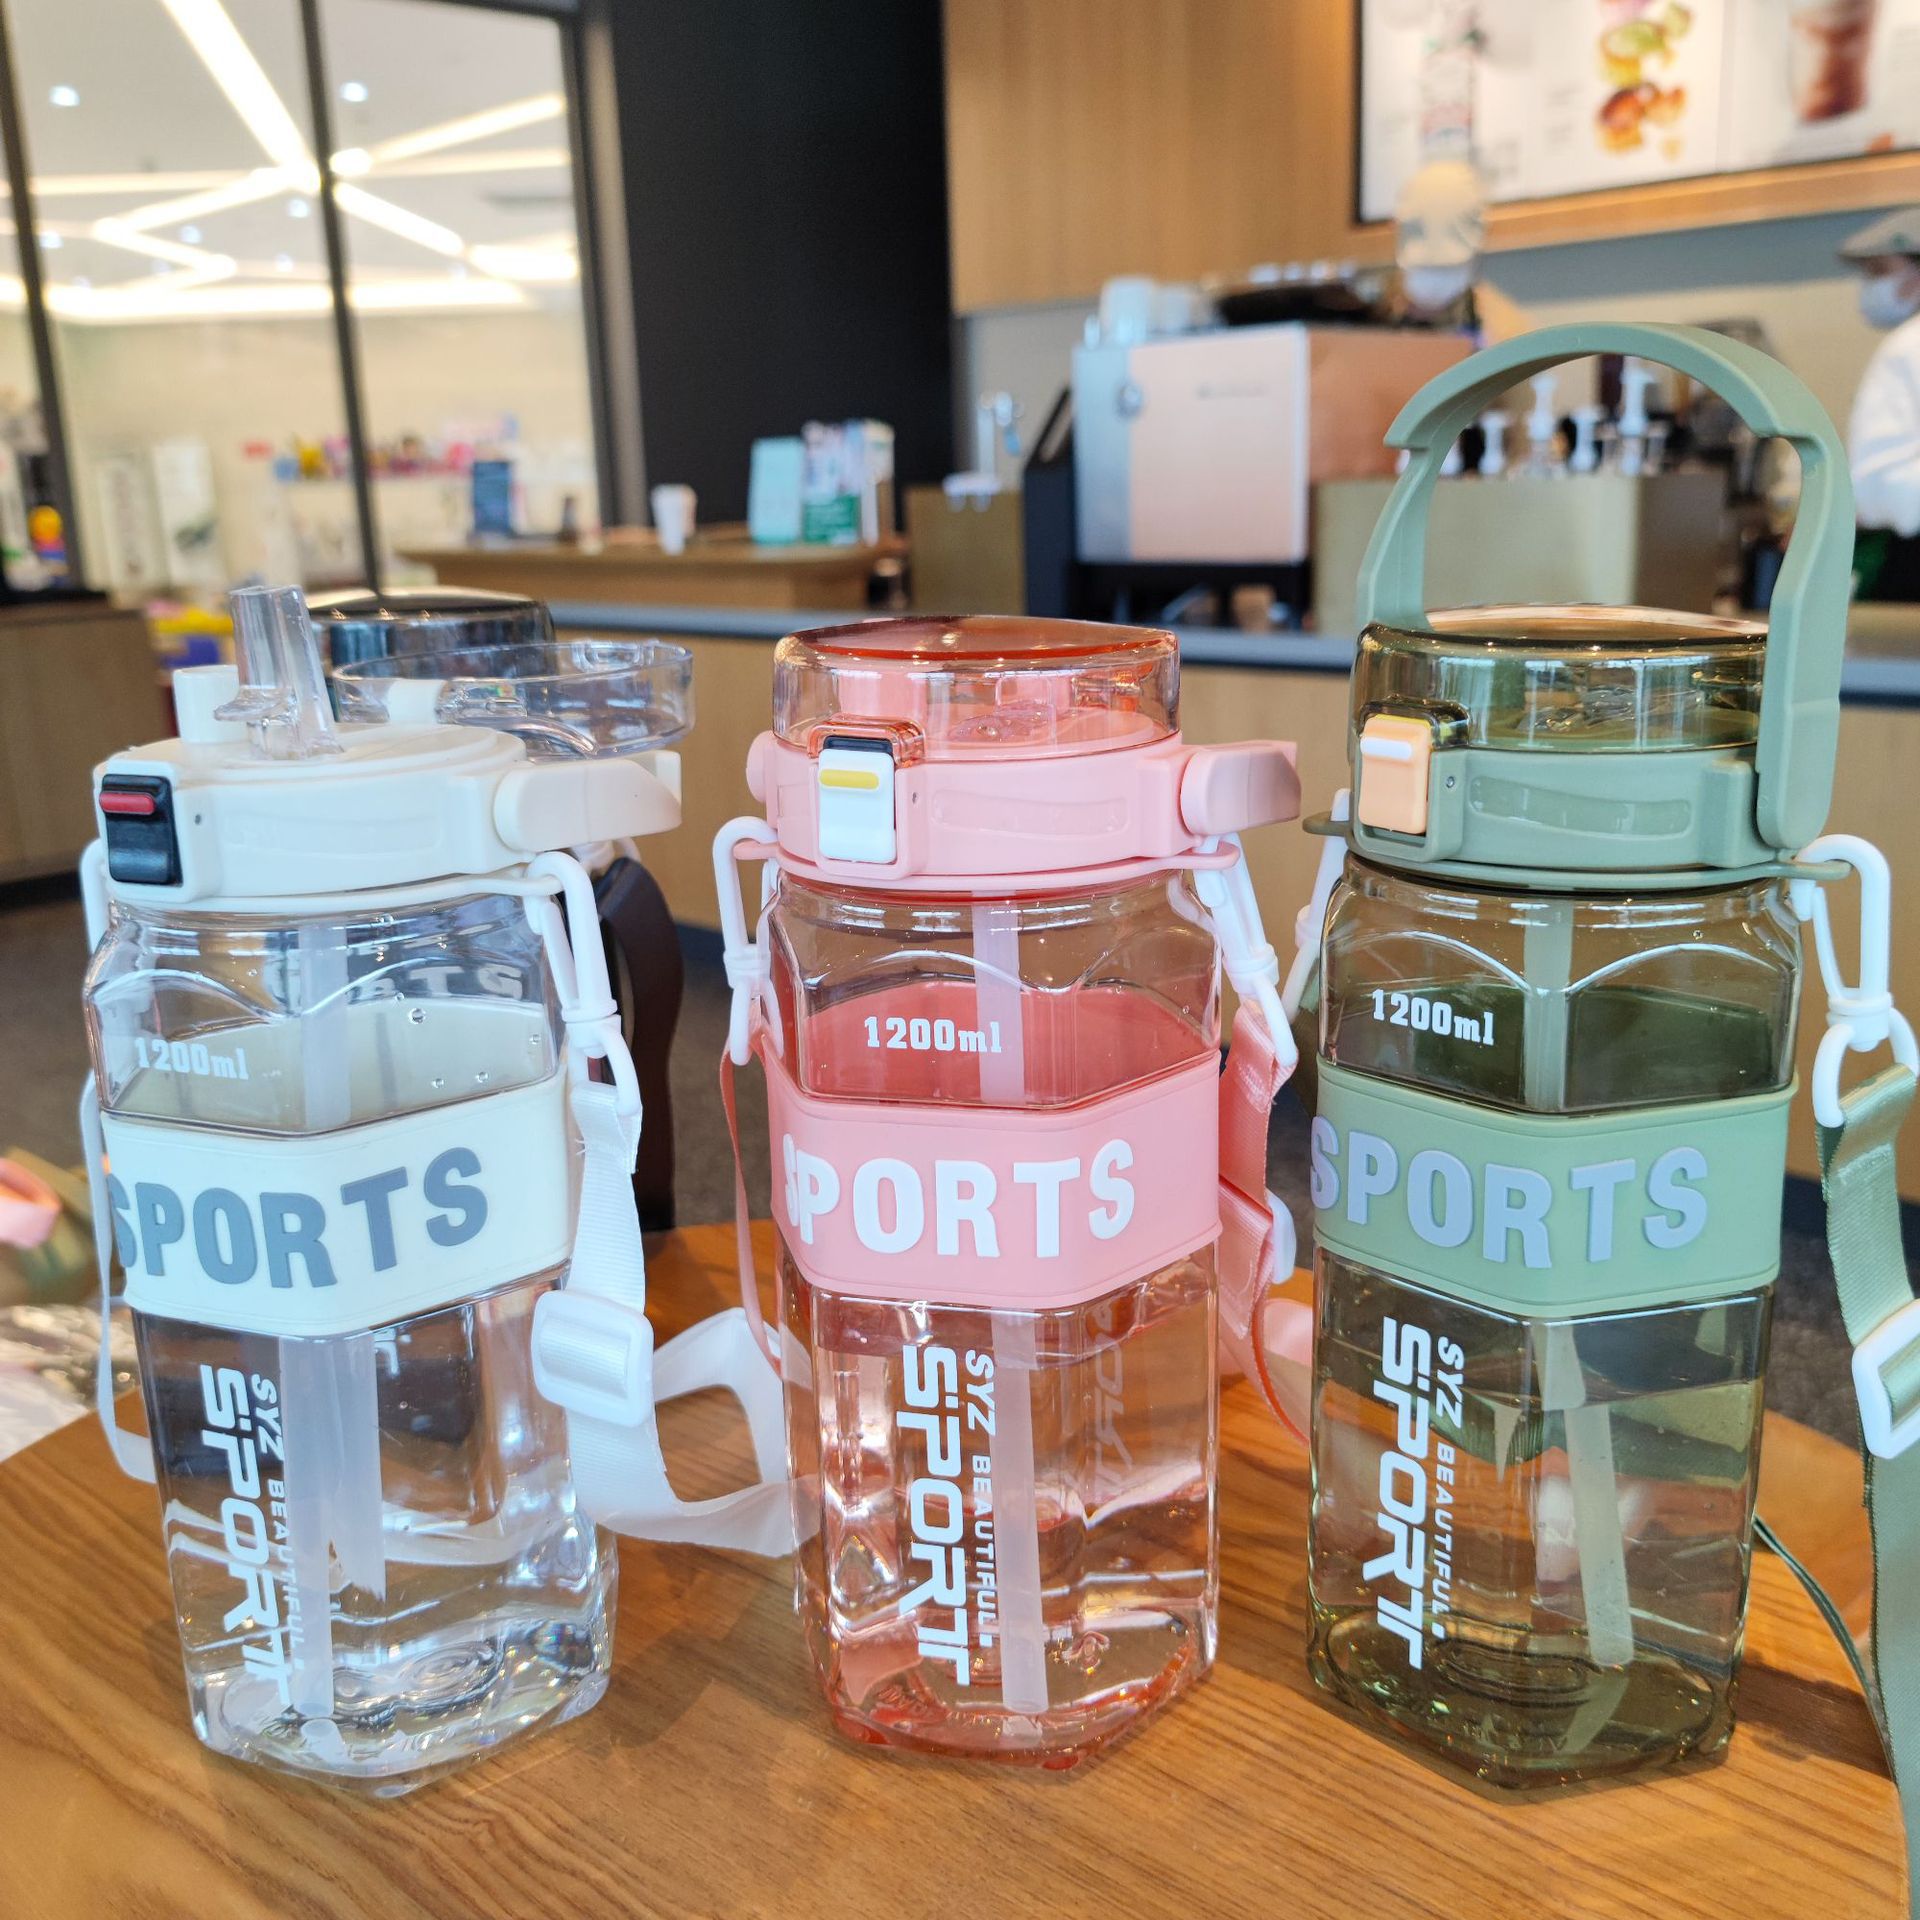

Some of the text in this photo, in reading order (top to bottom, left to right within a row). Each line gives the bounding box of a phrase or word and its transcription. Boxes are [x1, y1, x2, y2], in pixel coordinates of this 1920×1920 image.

[134, 1036, 250, 1081] 1200ml
[864, 1016, 1002, 1053] 1200ml
[1371, 989, 1494, 1047] 1200ml
[782, 1133, 1136, 1259] SPORTS
[1310, 1116, 1708, 1269] SPORTS
[250, 1373, 285, 1462] SYZ
[965, 1349, 997, 1437] SYZ
[1435, 1335, 1464, 1429] SYZ
[200, 1364, 295, 1707] SPORT
[896, 1344, 971, 1686] SPORT
[1362, 1316, 1433, 1671] SPORT
